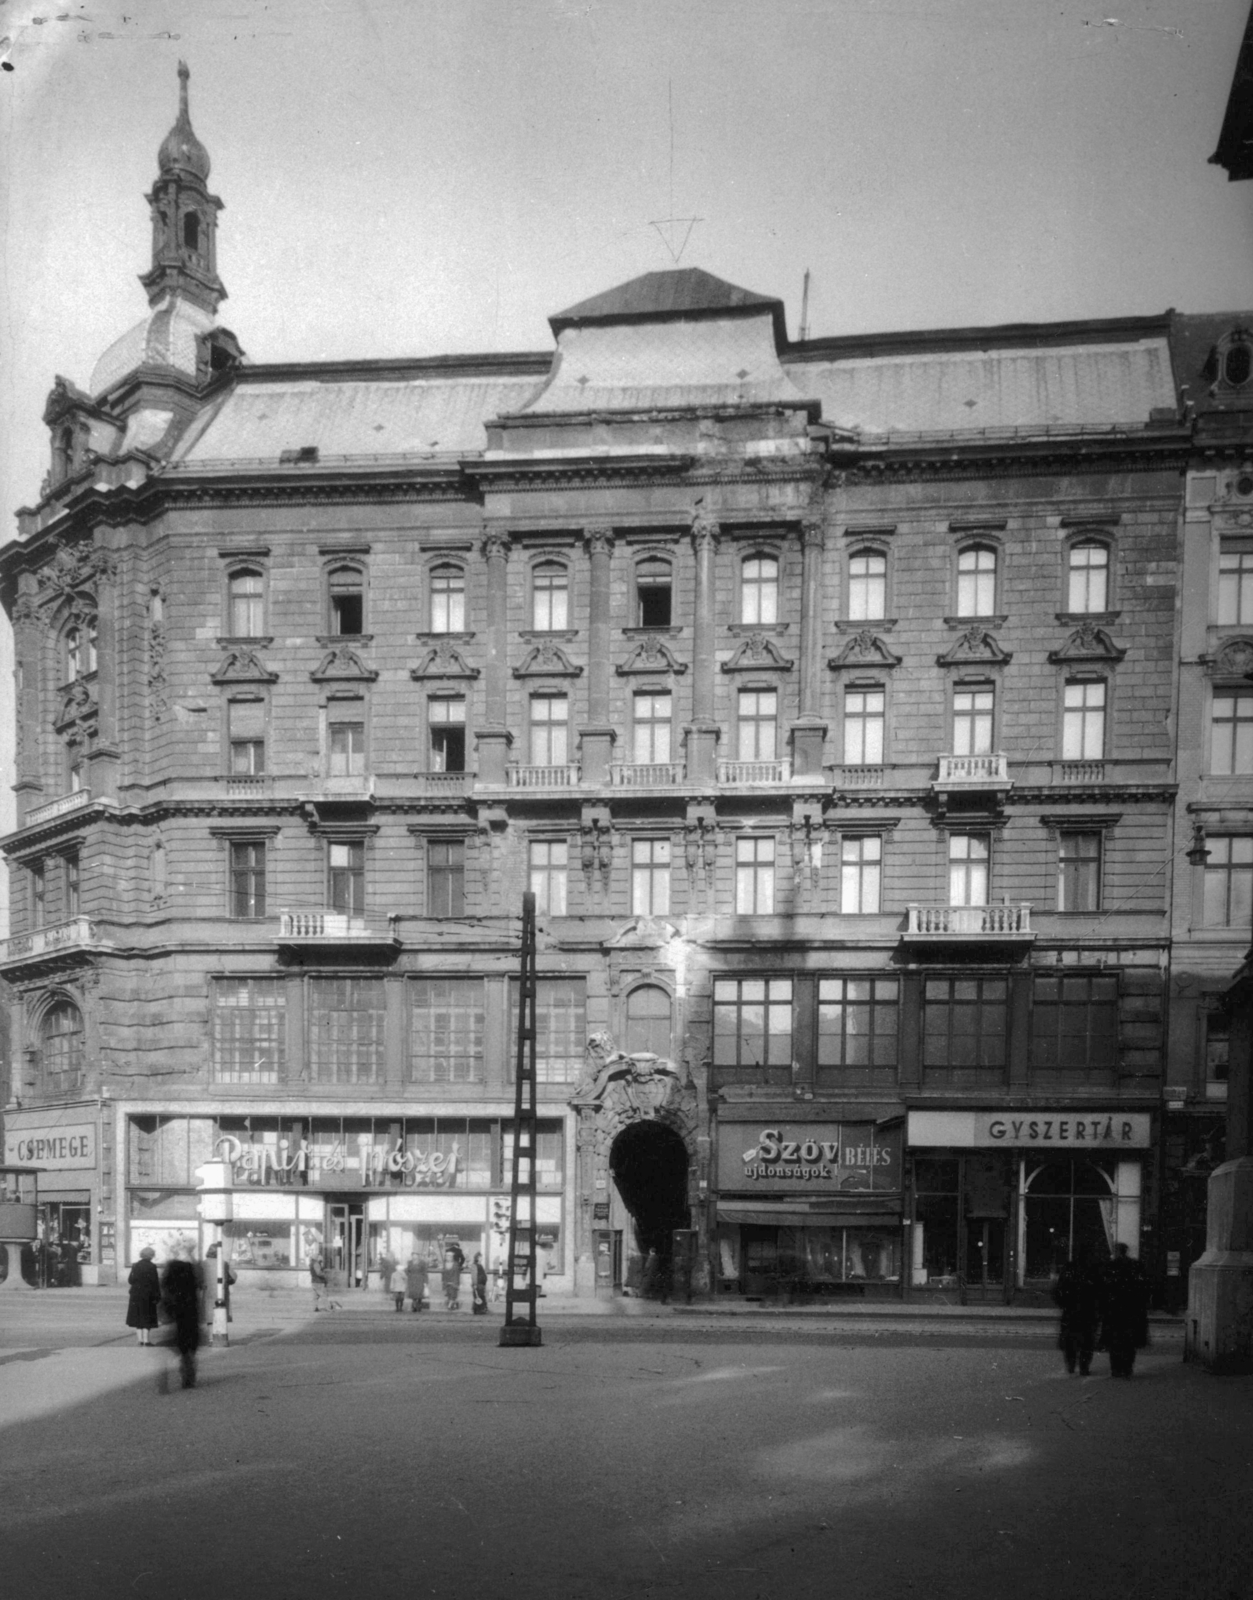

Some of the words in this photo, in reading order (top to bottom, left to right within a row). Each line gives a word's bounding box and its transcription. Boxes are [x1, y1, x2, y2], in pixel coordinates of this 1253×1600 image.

[989, 1116, 1133, 1140] GYSZERTÁR
[17, 1136, 88, 1161] CSEMEGE
[322, 1139, 345, 1171] és
[845, 1143, 892, 1166] BÉLÉS
